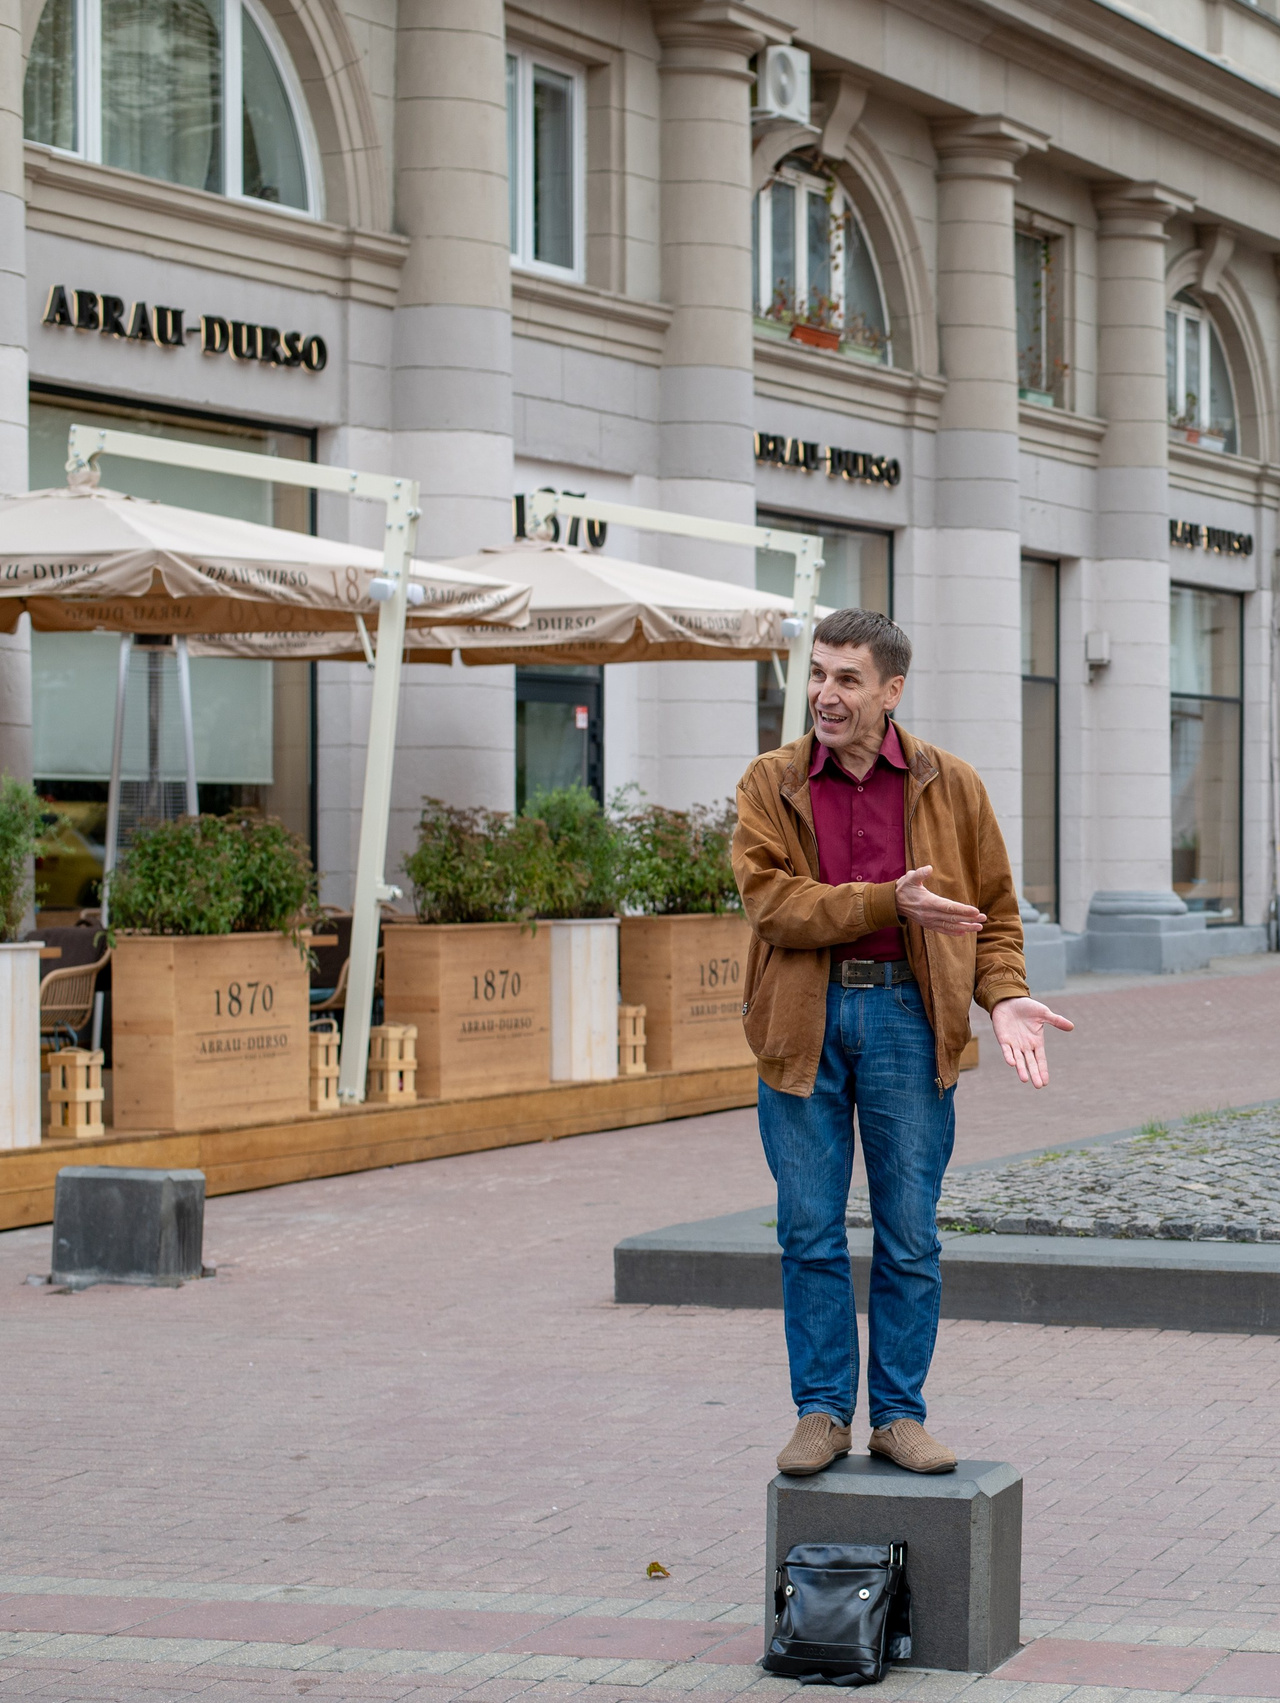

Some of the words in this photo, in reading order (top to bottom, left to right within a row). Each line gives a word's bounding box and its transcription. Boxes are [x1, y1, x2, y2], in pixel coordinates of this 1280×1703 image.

[40, 284, 328, 372] ABRAU-DURSO
[473, 968, 521, 1001] 1870
[699, 957, 740, 988] 1870
[214, 981, 274, 1018] 1870
[460, 1017, 532, 1034] ABRAU-DURSO
[200, 1033, 288, 1055] ABRAU-DURSO
